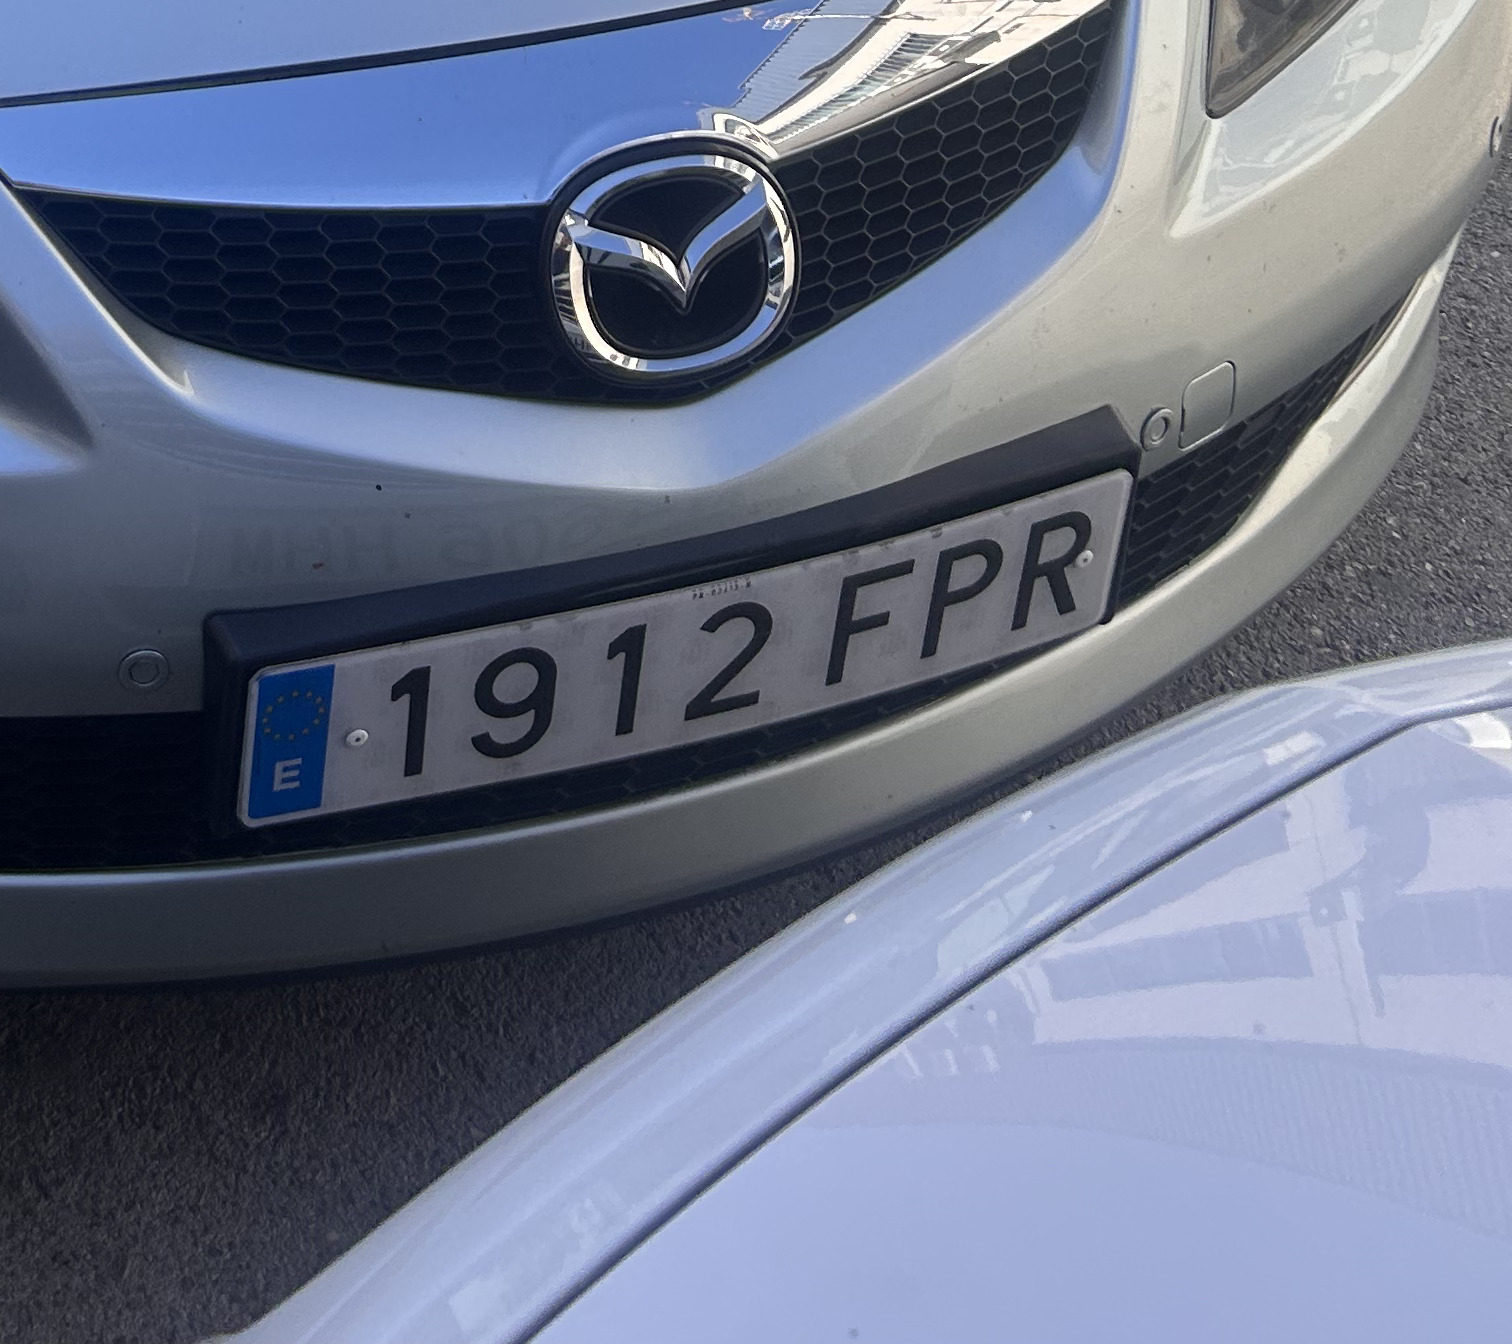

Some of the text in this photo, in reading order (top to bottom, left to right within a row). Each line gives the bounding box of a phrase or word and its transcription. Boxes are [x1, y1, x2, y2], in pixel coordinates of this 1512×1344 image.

[390, 510, 1093, 778] 1912 FPR
[272, 757, 305, 795] E
